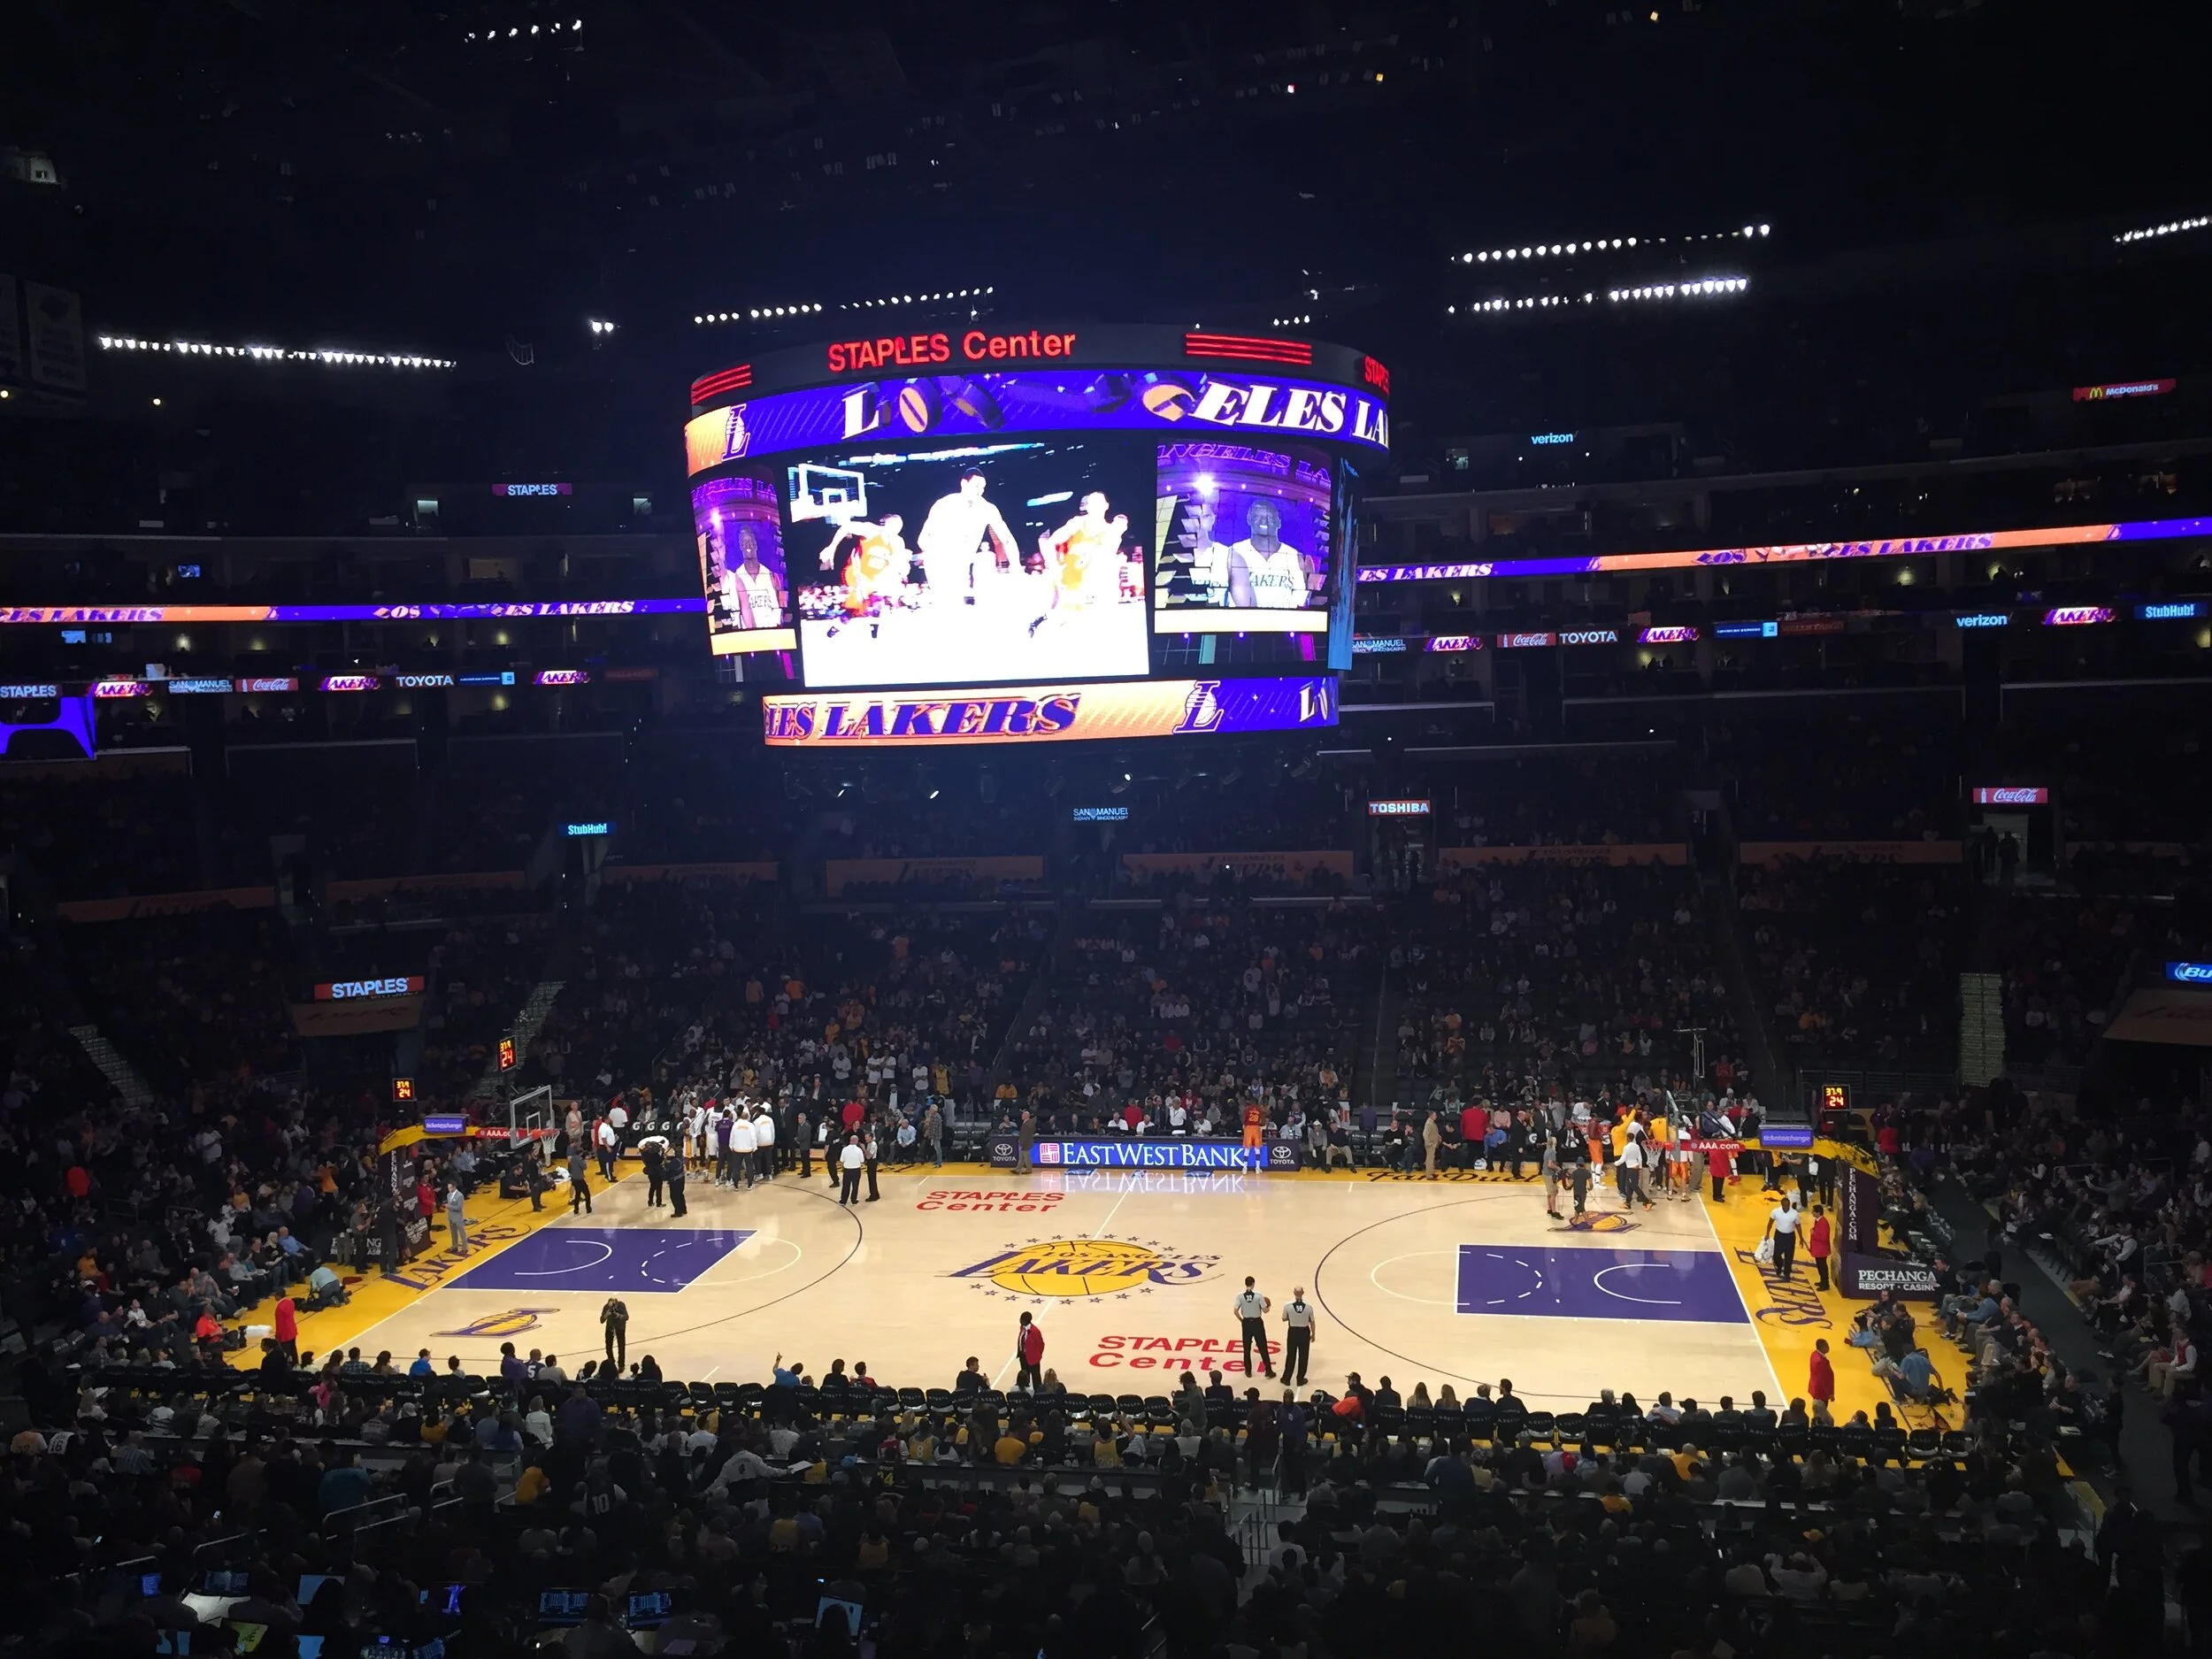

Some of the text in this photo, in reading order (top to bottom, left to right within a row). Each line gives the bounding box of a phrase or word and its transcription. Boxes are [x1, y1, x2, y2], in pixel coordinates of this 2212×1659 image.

[828, 331, 1076, 373] STAPLES Center
[2106, 384, 2159, 396] McDonald's
[1531, 433, 1573, 444] verizon
[508, 484, 557, 495] STAPLES
[1394, 563, 1494, 580] LAKERS
[538, 601, 635, 616] LAKERS
[2145, 603, 2195, 618] StubHub!
[1956, 614, 2008, 627] verizon
[1559, 630, 1617, 644] TOYOTA
[396, 675, 454, 687] TOYOTA
[0, 684, 57, 698] STAPLES
[819, 693, 1081, 740] LAKERS
[1993, 787, 2039, 803] Coca-Cola
[1370, 802, 1430, 814] TOSHIBA
[567, 823, 608, 835] StubHub!
[332, 977, 409, 999] STAPLES
[502, 1050, 513, 1067] 24
[399, 1089, 411, 1098] 24
[1825, 1087, 1842, 1096] 37.9
[1829, 1096, 1844, 1106] 24
[1699, 1141, 1740, 1150] AAA.com
[926, 1191, 1065, 1202] STAPLES
[917, 1201, 1057, 1212] Center
[933, 1250, 1225, 1286] LAKERS
[1858, 1270, 1936, 1282] PECHANGA
[1097, 1336, 1281, 1355] STAPLES
[917, 1444, 924, 1458] 8
[592, 1493, 610, 1515] 10
